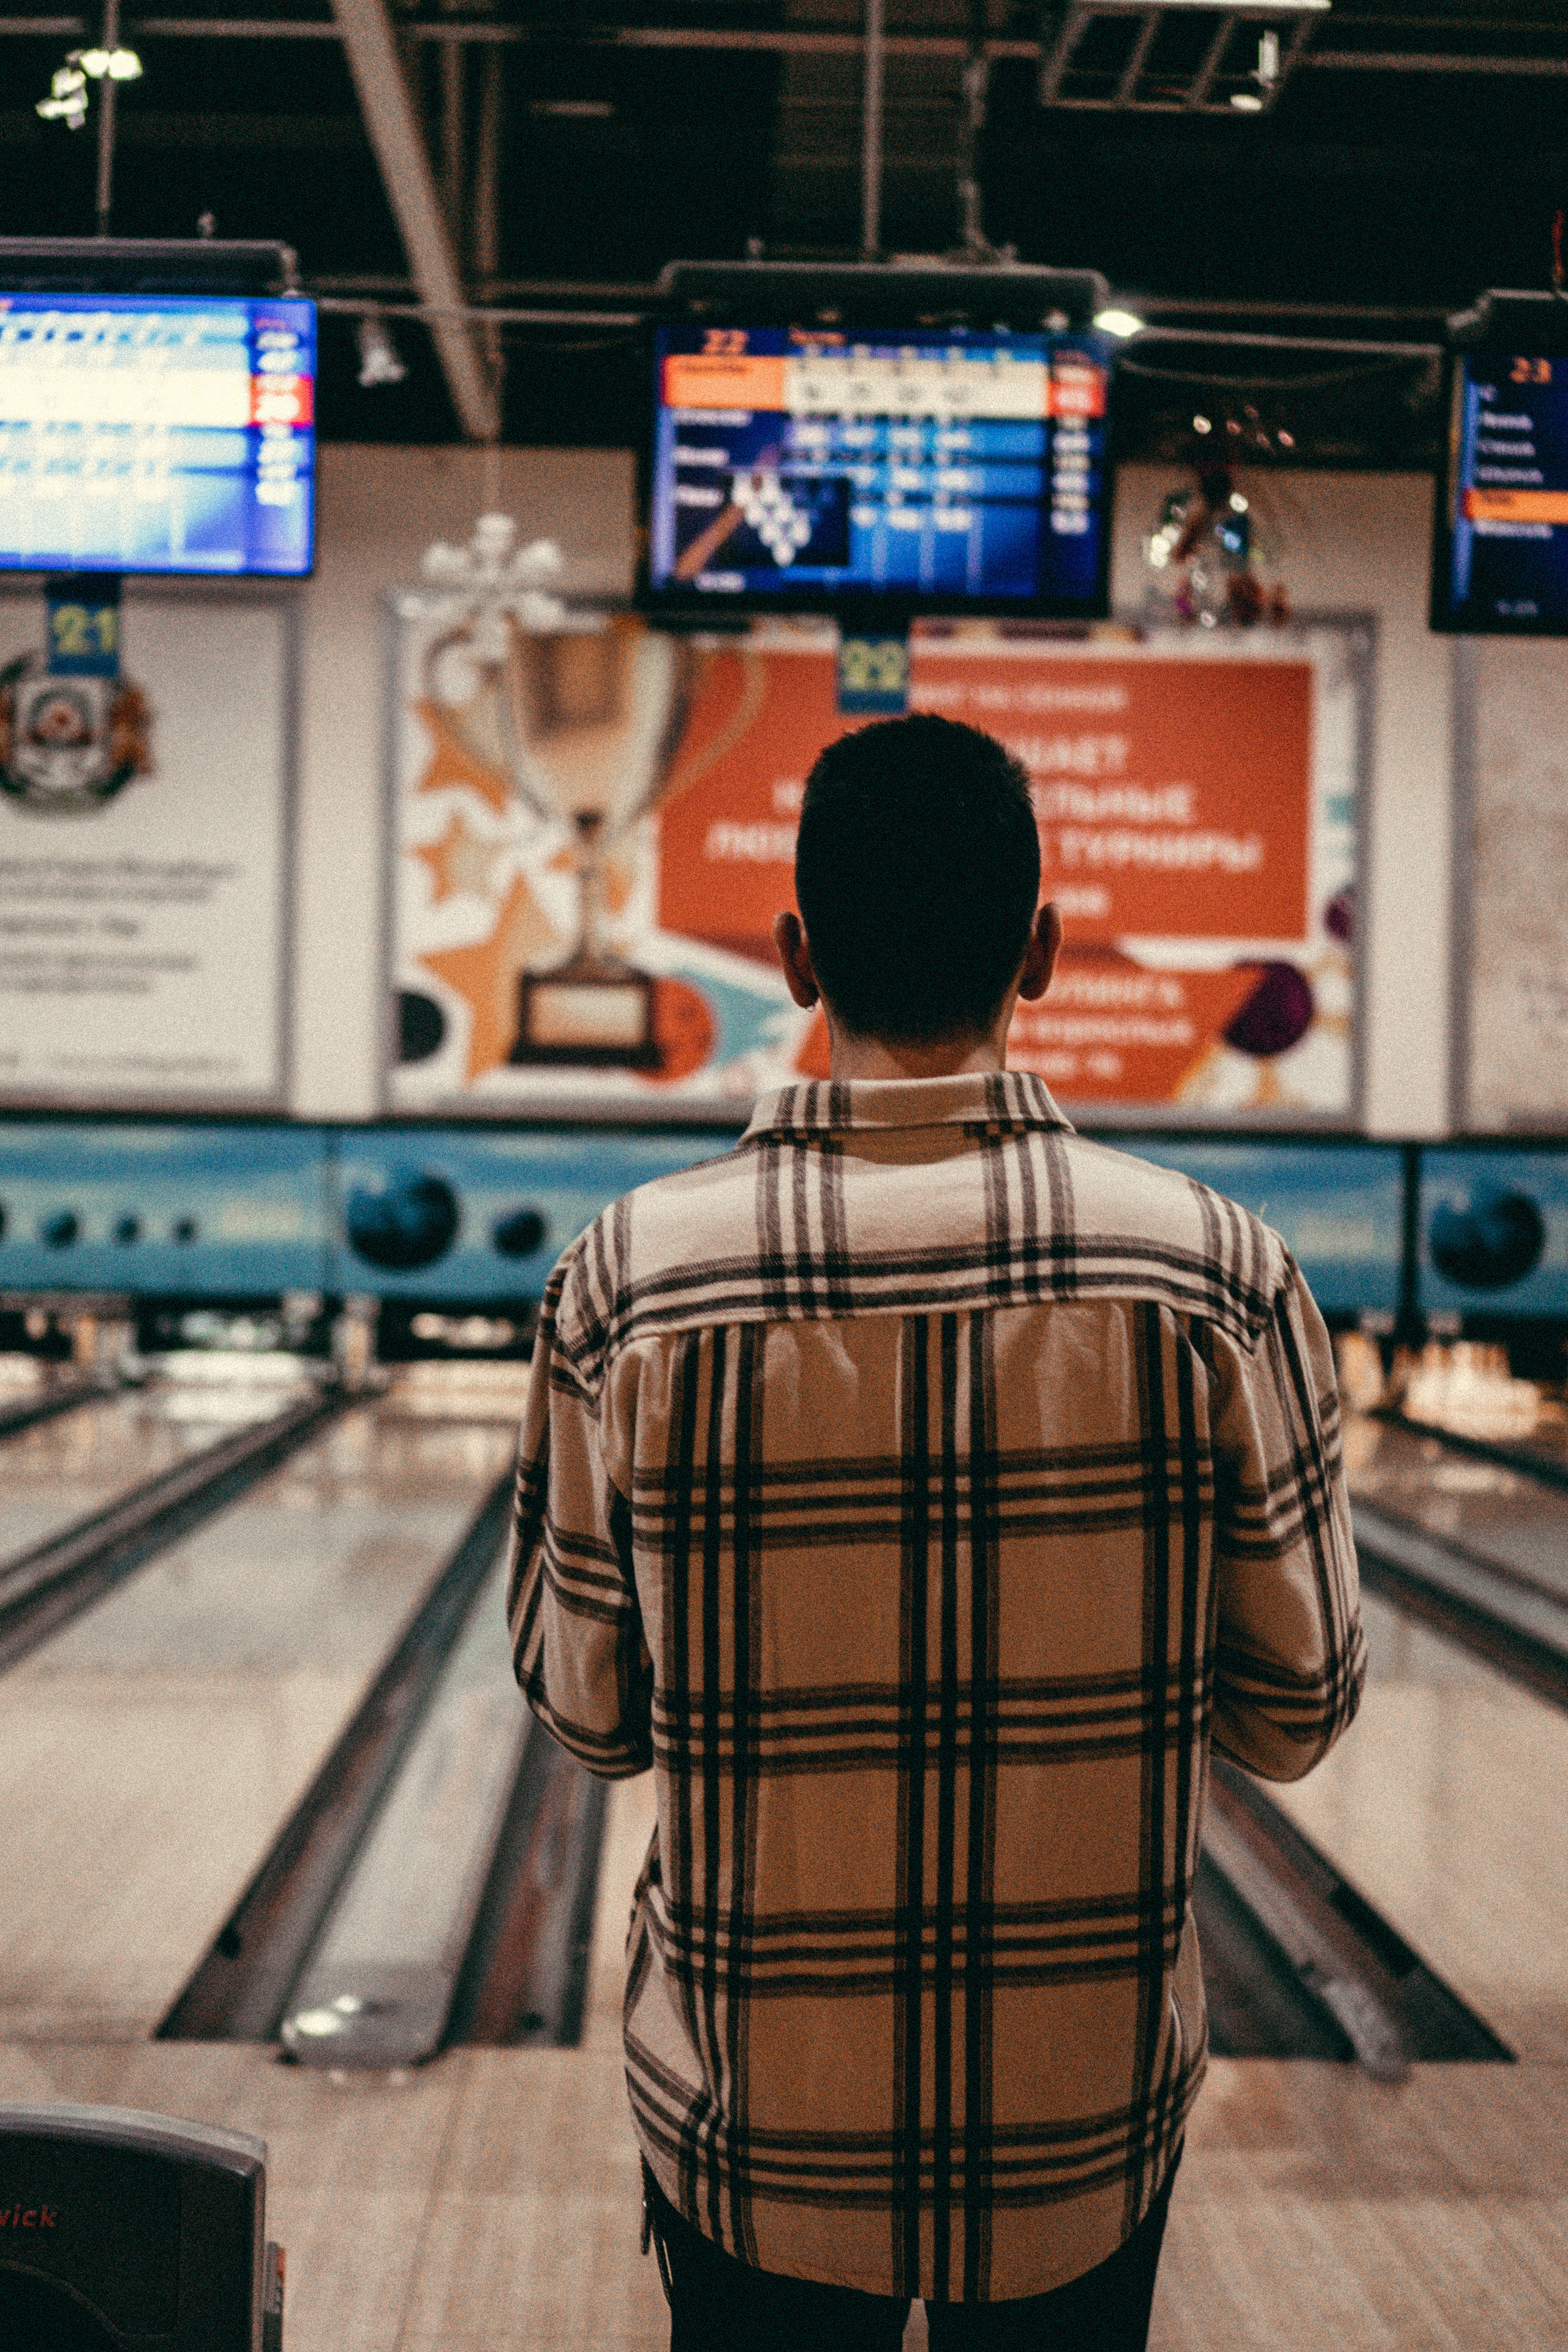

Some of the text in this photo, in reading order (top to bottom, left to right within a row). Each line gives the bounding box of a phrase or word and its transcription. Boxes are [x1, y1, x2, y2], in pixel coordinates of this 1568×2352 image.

[701, 328, 750, 355] 22
[1510, 356, 1553, 383] 23
[53, 604, 118, 655] 21
[841, 640, 907, 690] 22
